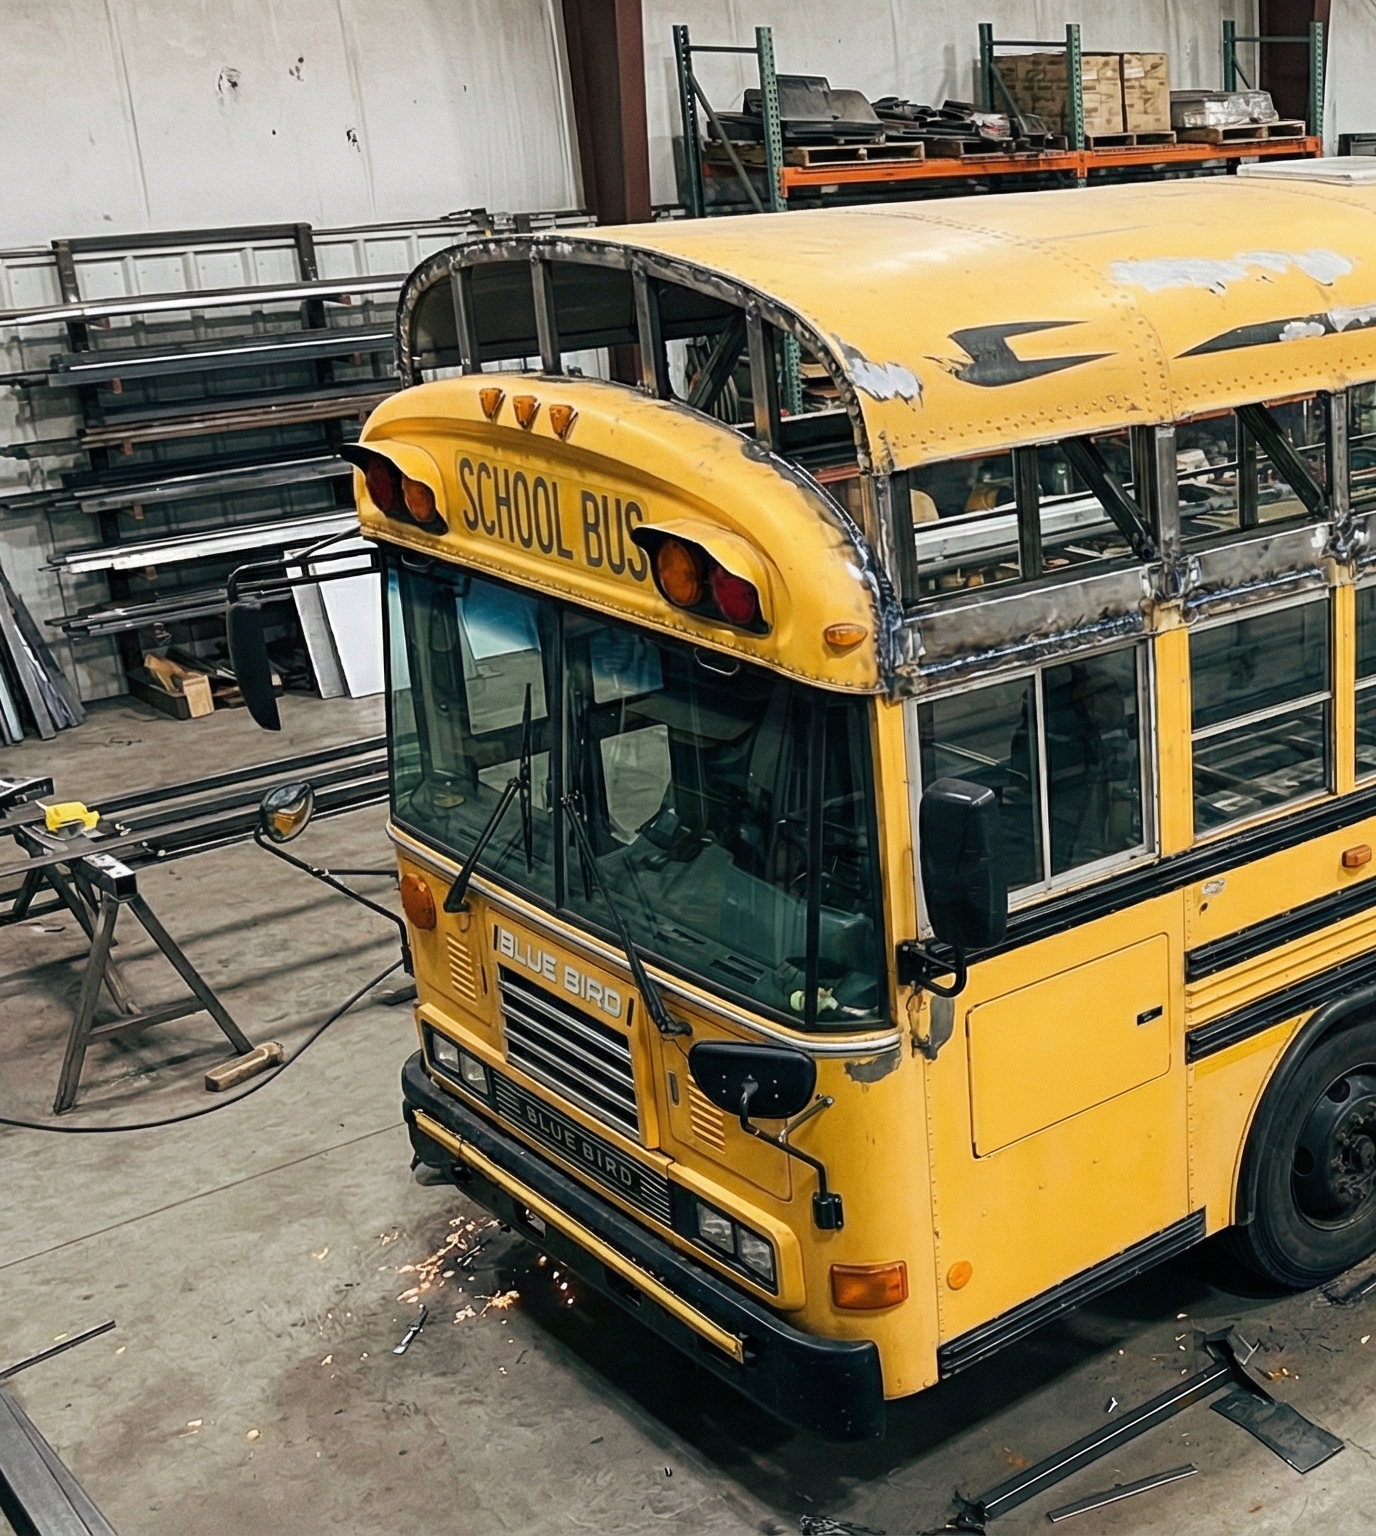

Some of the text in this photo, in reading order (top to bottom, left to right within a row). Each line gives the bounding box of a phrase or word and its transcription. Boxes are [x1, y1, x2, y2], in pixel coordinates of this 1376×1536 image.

[459, 457, 648, 582] SCHOOL BUS
[500, 928, 622, 1019] BLUE BIRD
[526, 1104, 633, 1187] BLUE BIRD
